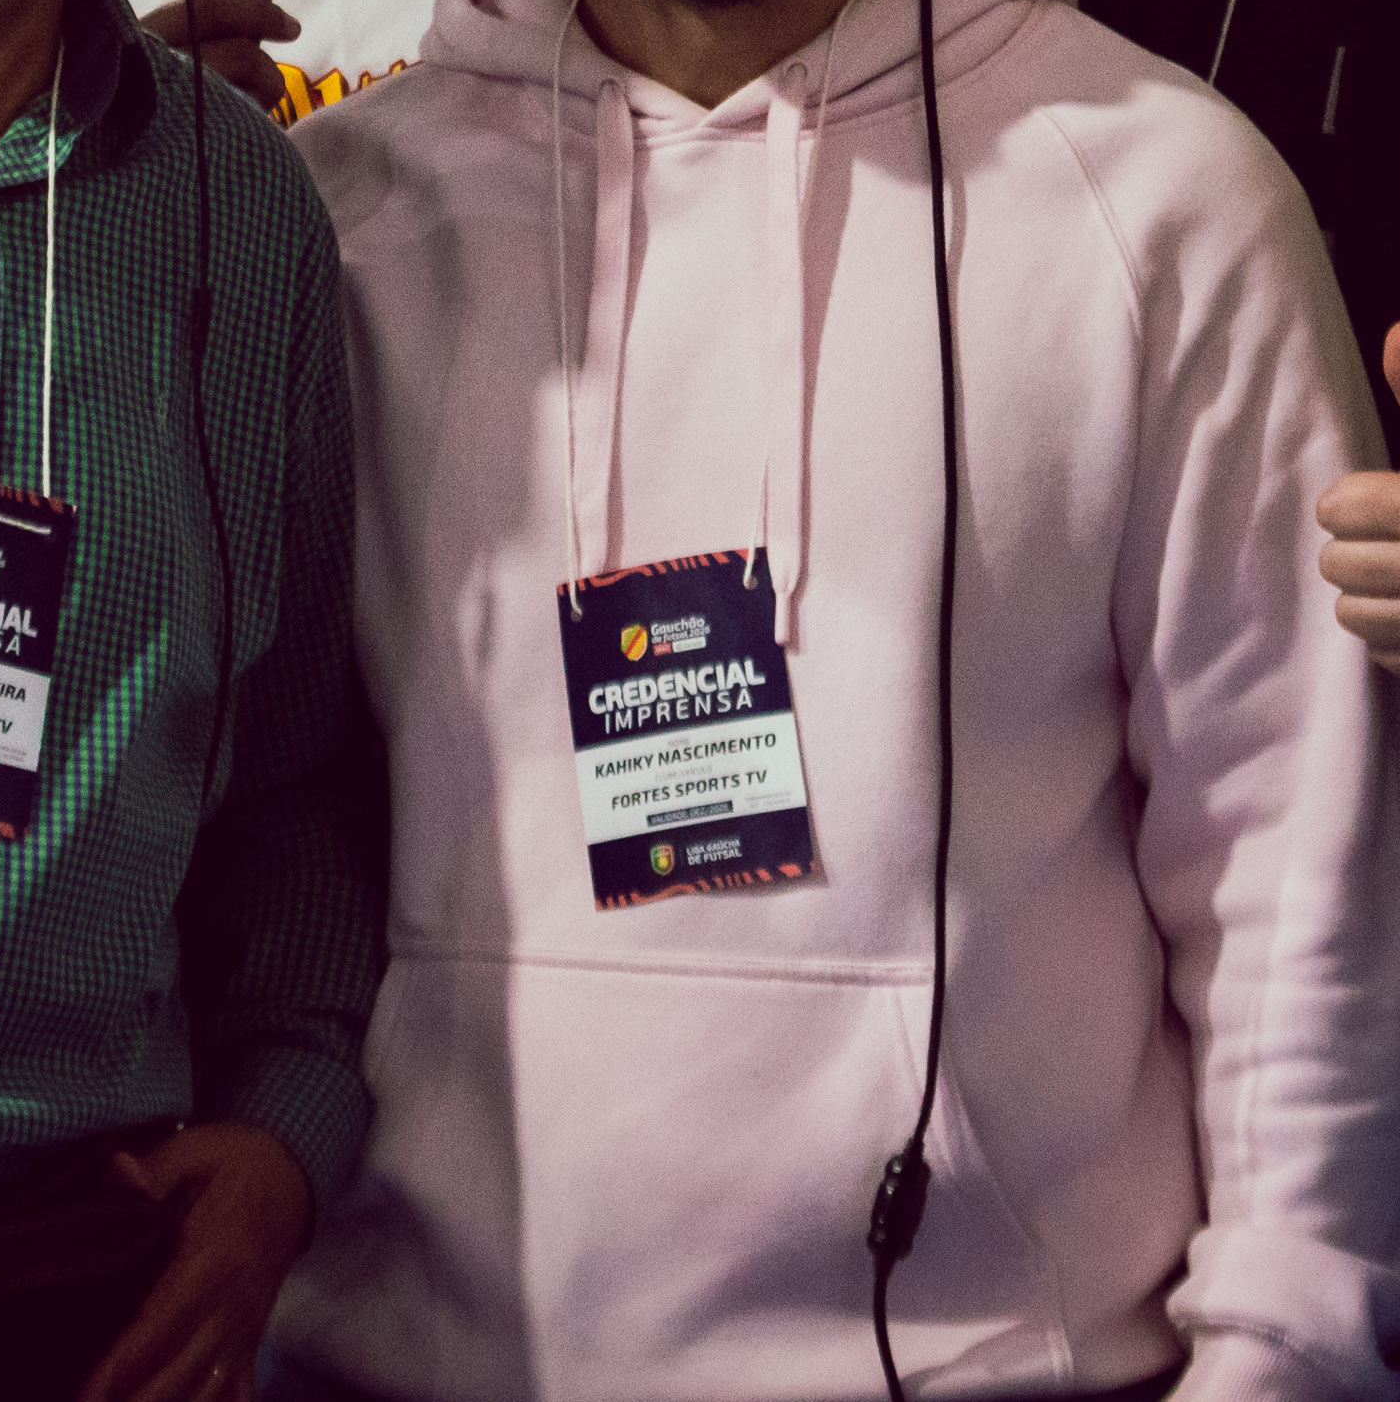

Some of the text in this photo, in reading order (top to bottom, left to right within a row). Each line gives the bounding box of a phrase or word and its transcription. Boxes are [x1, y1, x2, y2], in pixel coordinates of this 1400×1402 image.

[651, 616, 705, 637] Gauchão
[588, 657, 766, 715] CREDENCIAL
[605, 691, 753, 734] IMPRENSA
[595, 733, 777, 779] KAHIKY NASCIMENTO
[612, 769, 767, 810] FORTES SPORTS TV
[688, 848, 742, 866] DE FUTSAL
